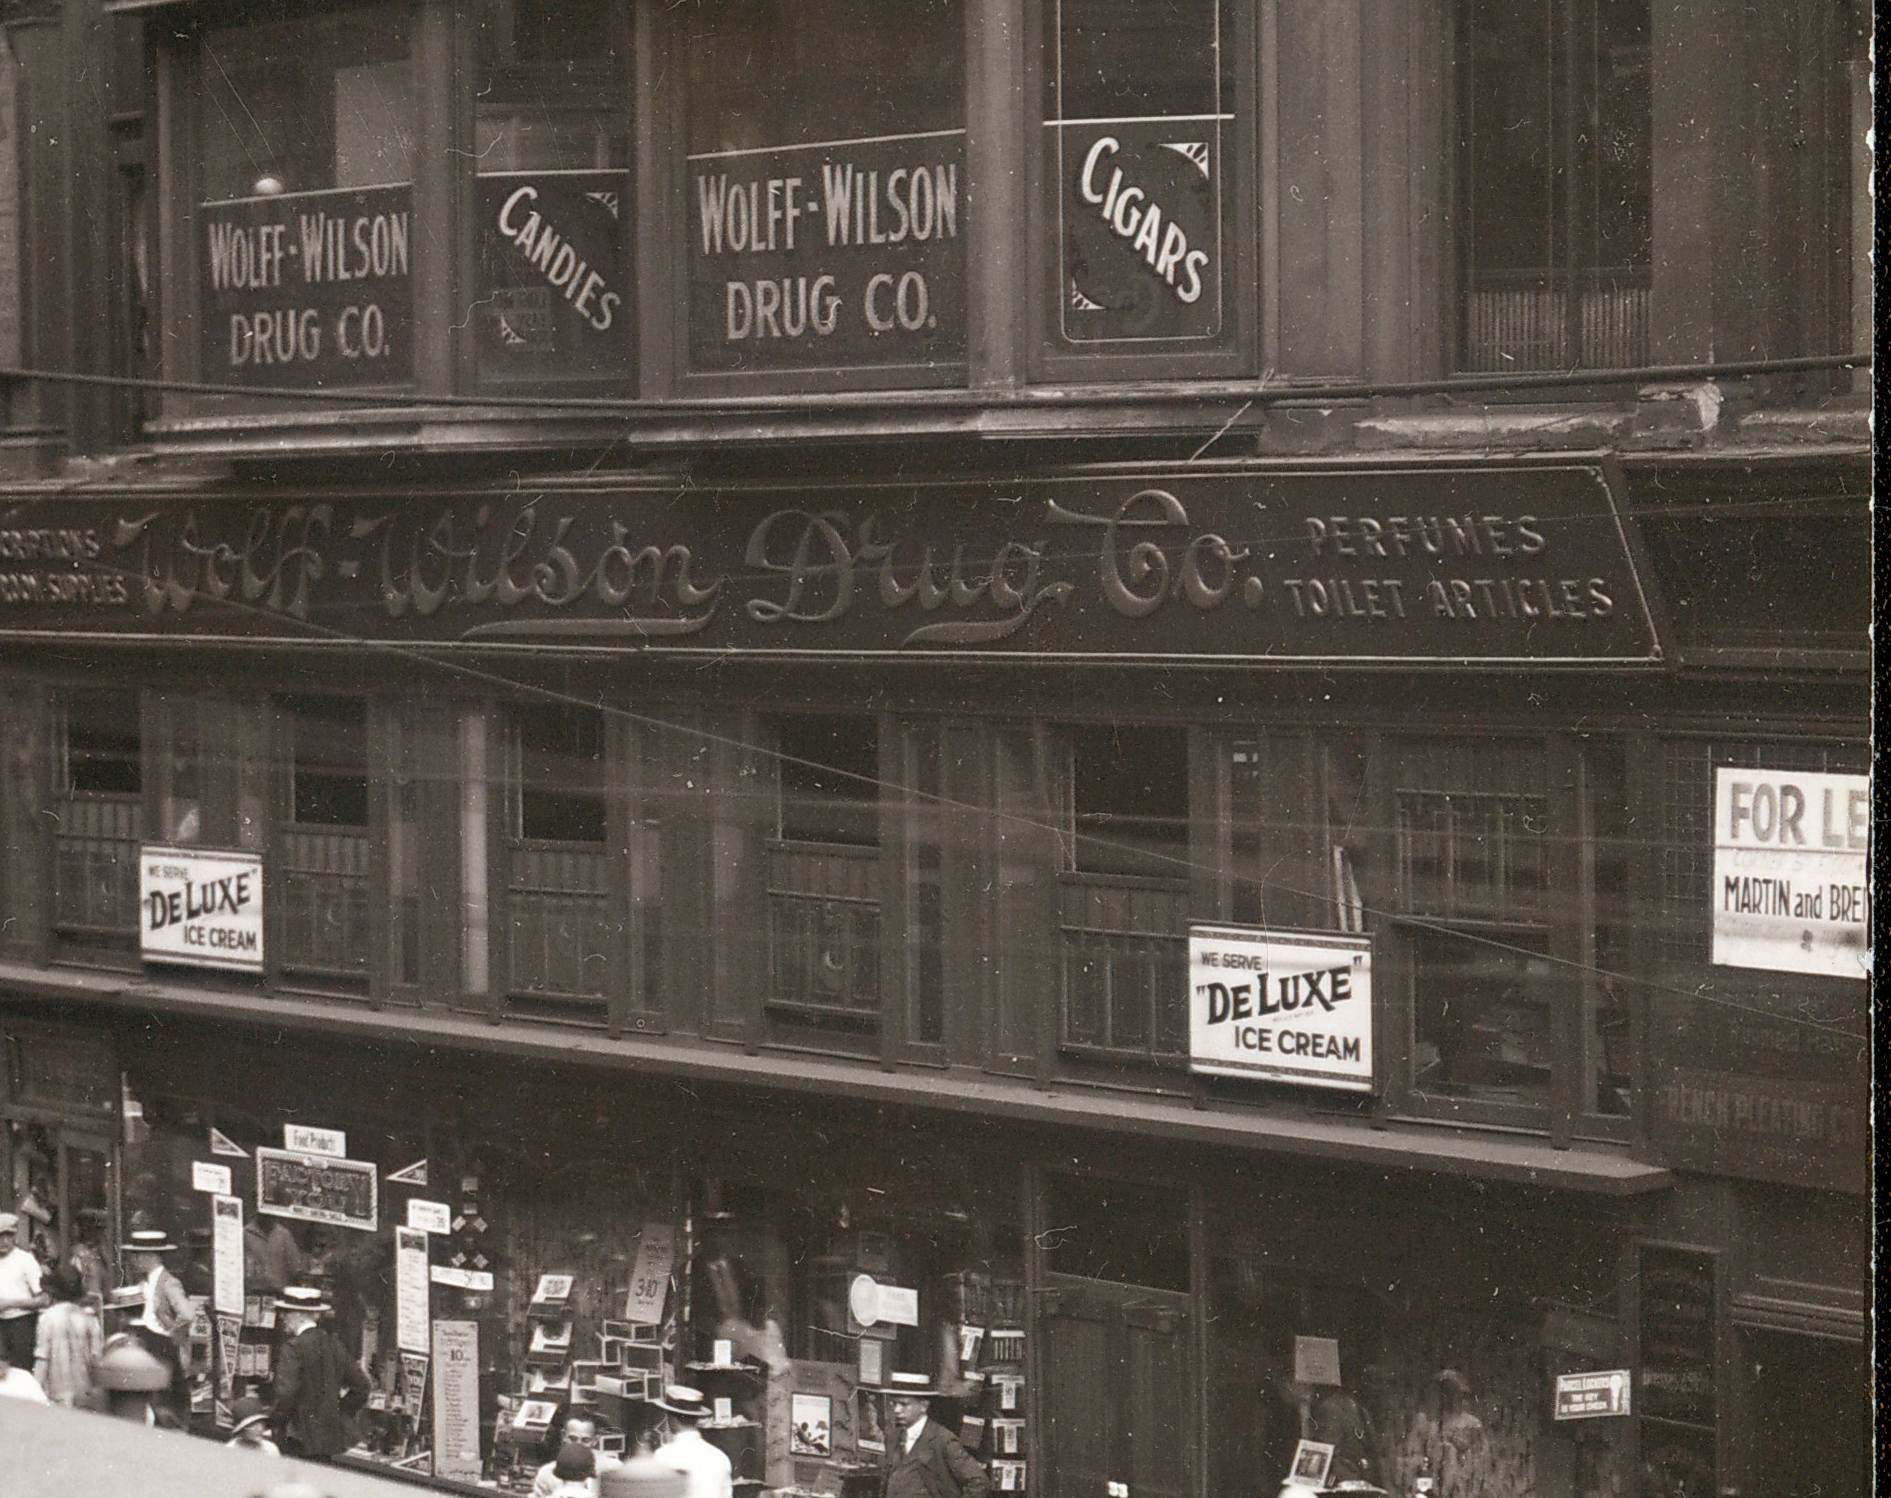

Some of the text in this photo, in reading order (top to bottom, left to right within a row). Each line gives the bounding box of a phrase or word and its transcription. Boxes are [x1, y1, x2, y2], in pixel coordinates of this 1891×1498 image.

[698, 163, 958, 255] WOLFF-WILSON
[1081, 137, 1209, 304] CIGARS
[208, 211, 409, 290] WOLFF-WILSON
[499, 186, 621, 331] CANDIES
[230, 305, 390, 365] DRUG CO.
[726, 270, 938, 341] DRUG CO.
[743, 508, 1075, 626] Drug
[1048, 489, 1264, 620] Co.
[1307, 514, 1547, 559] PERFUMES
[1285, 576, 1614, 622] TOILET ARTICLES
[1730, 780, 1807, 846] FOR
[1724, 875, 1791, 917] MARTIN
[1794, 885, 1823, 920] and
[183, 925, 257, 952] ICE CREAM
[1201, 951, 1263, 971] WE SERVE
[1234, 1025, 1361, 1063] ICE CREAM
